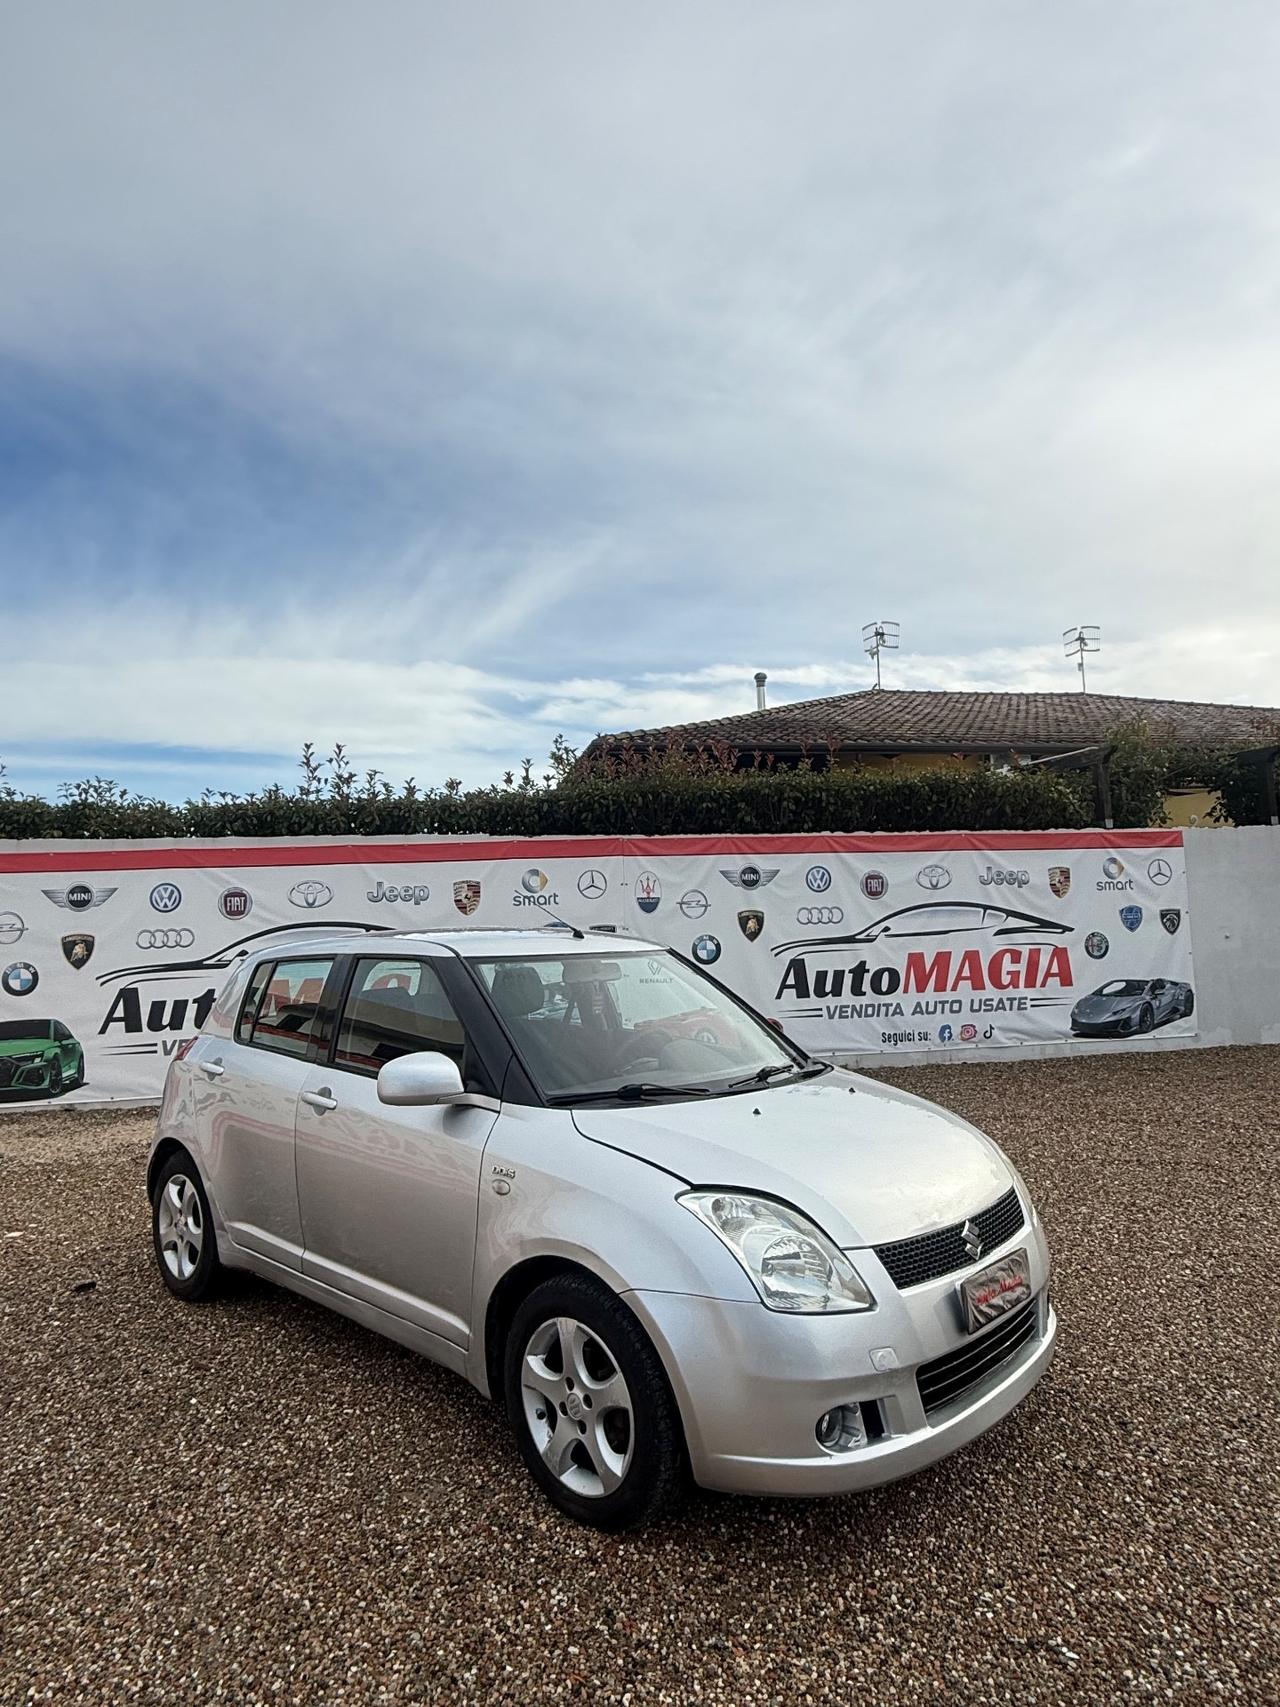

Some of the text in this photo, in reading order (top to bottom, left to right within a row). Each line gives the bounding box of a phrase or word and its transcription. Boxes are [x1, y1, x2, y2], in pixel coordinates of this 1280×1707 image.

[740, 873, 760, 881] MINI
[979, 866, 1030, 889] Jeep
[867, 880, 882, 892] FIAT
[1096, 879, 1134, 891] smart
[68, 892, 91, 901] MINI
[367, 882, 430, 905] Jeep
[513, 893, 559, 907] smart
[226, 897, 246, 912] FIAT
[98, 987, 217, 1035] Aut
[826, 996, 1029, 1020] VENDITA AUTO USATE
[881, 1030, 932, 1046] Seguici su:
